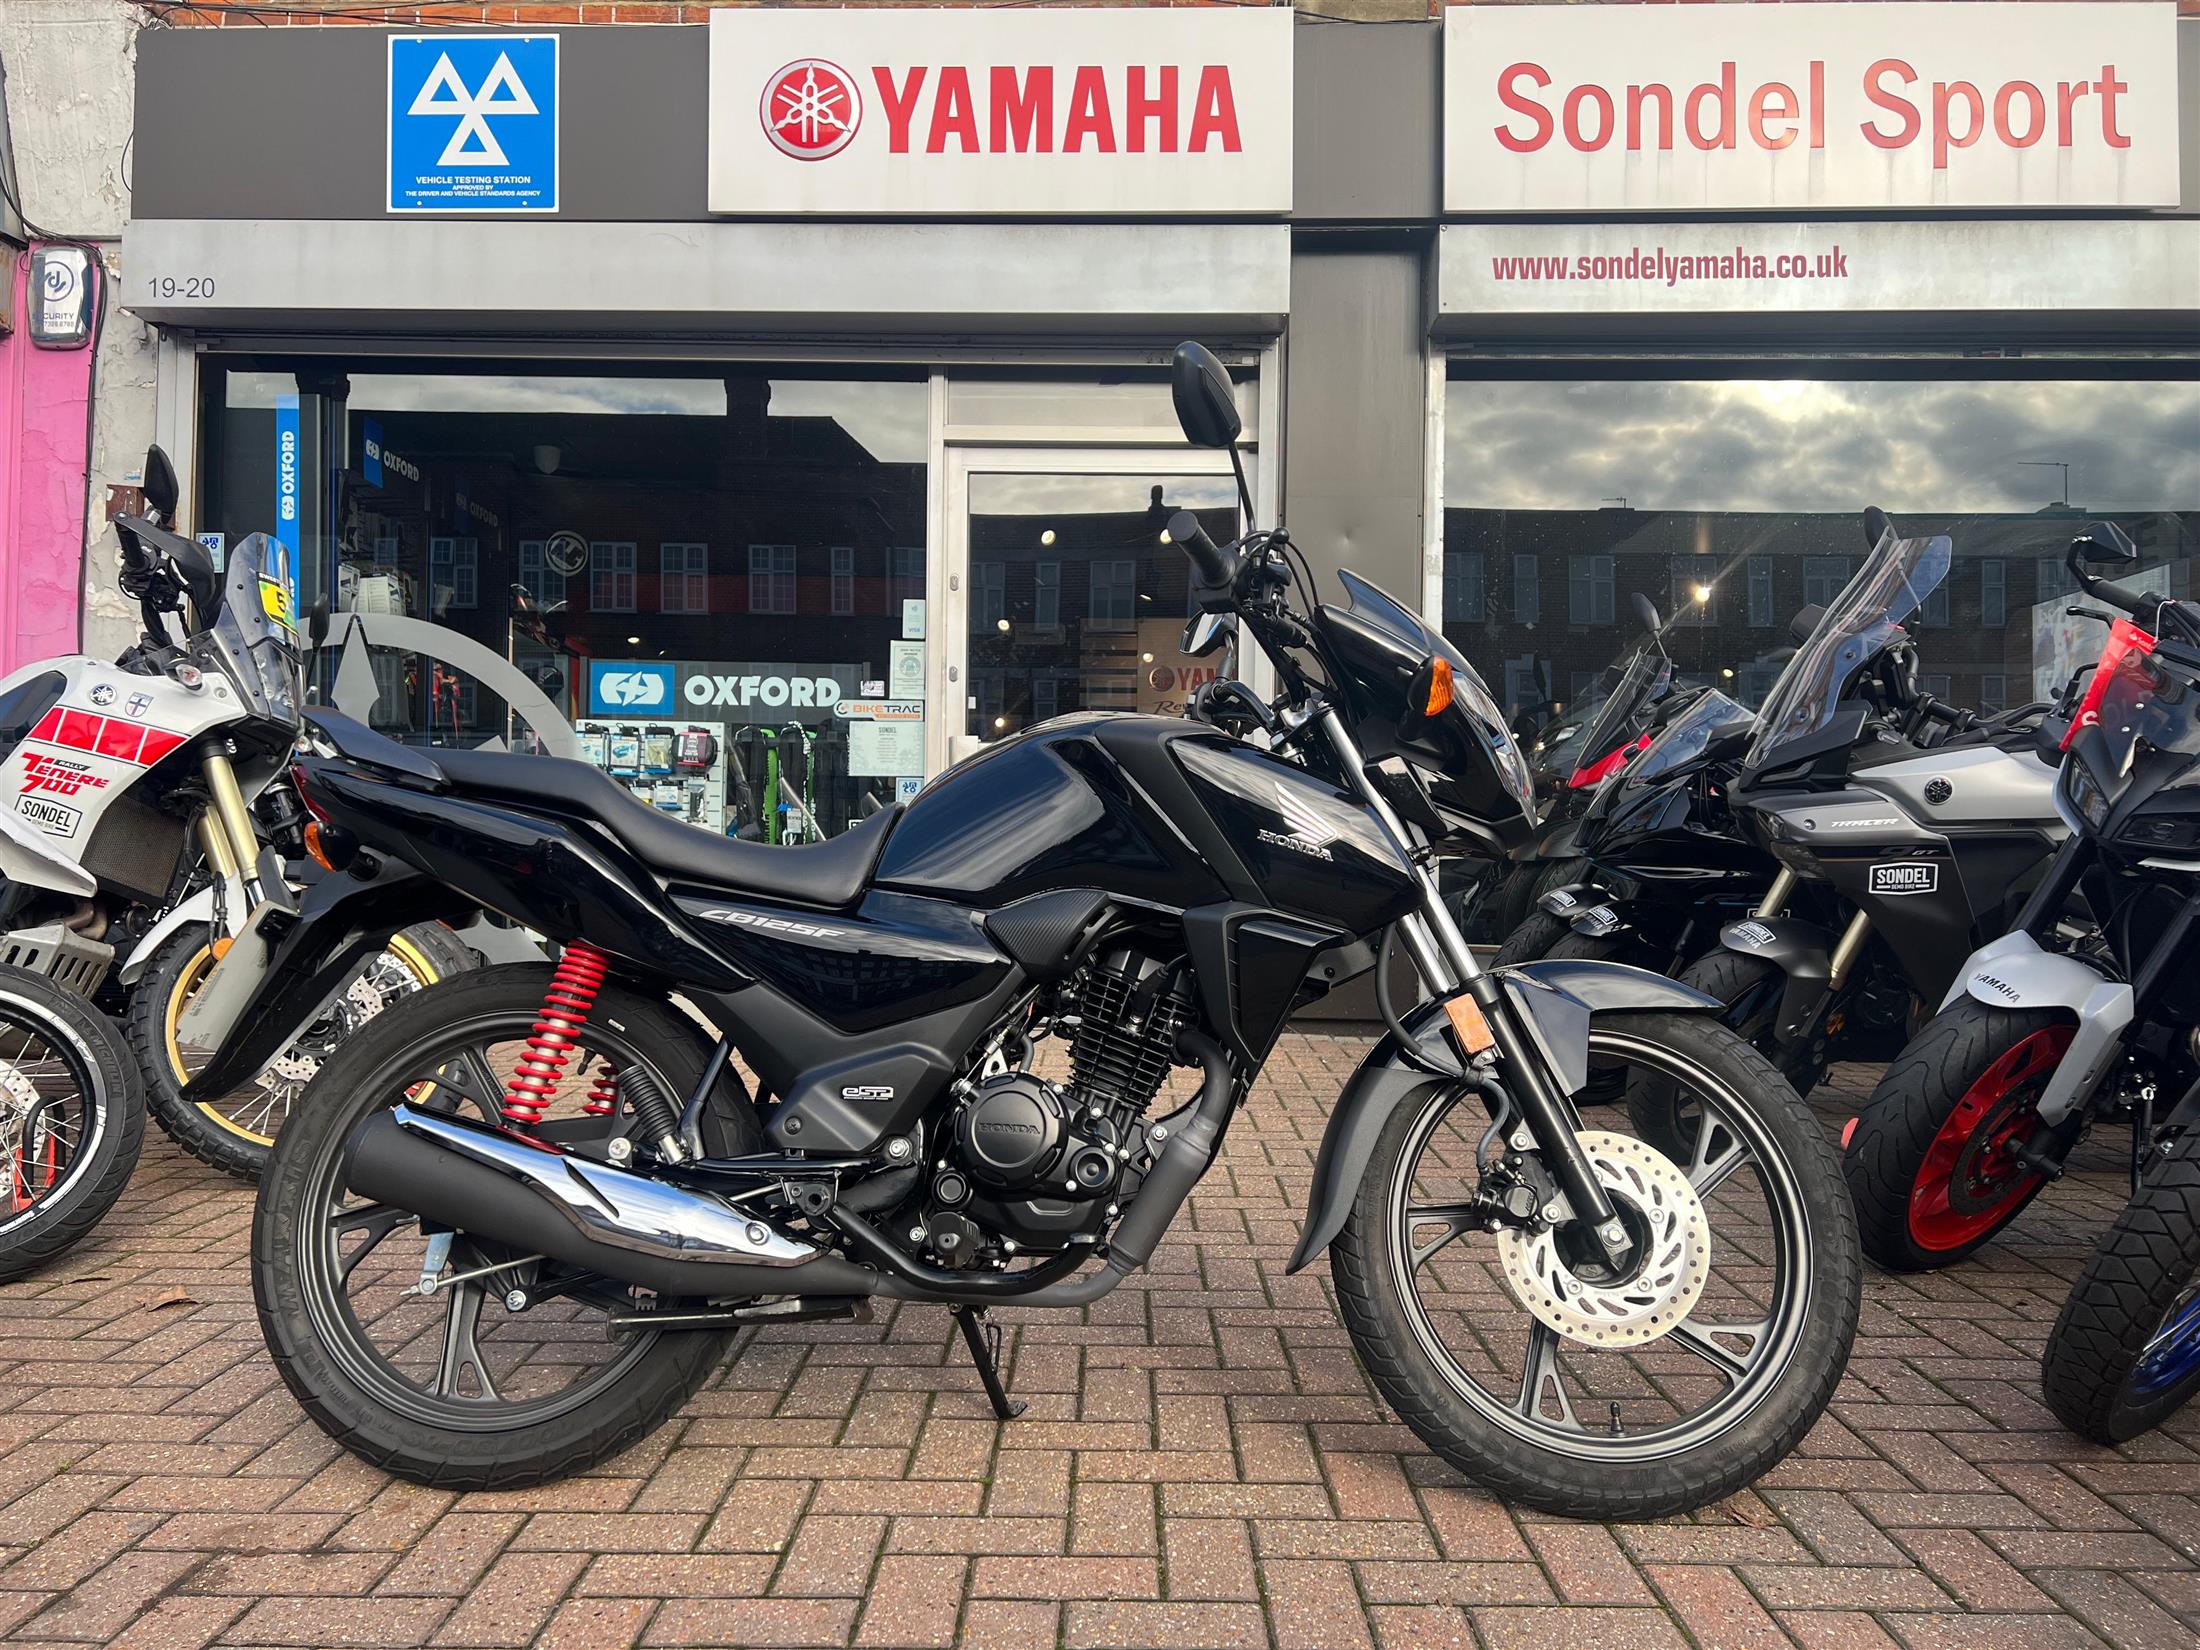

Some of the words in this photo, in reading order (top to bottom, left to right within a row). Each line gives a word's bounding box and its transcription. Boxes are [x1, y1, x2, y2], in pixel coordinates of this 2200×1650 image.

[871, 65, 1242, 153] YAMAHA
[1494, 60, 1824, 152] Sondel
[1860, 58, 2132, 169] Sport
[416, 176, 452, 184] VEHICLE
[454, 176, 492, 184] TESTING
[493, 176, 531, 184] STATION
[1493, 245, 1848, 287] www.sondelyamaha.co.uk
[149, 277, 215, 298] 19-20
[281, 430, 295, 495] OXFORD
[383, 449, 420, 482] OXFORD
[683, 674, 841, 707] OXFORD
[853, 704, 921, 713] BIKETRAC
[57, 759, 86, 771] RALLY
[19, 774, 81, 796] 700
[21, 800, 71, 828] SONDEL
[1831, 818, 1899, 828] TRACER
[1257, 829, 1334, 862] HONDA
[1876, 867, 1931, 884] SONDEL
[699, 909, 846, 938] CB125F
[1728, 927, 1762, 950] YAMAHA
[1974, 973, 2021, 1003] YAMAHA
[976, 1122, 1042, 1136] HONDA
